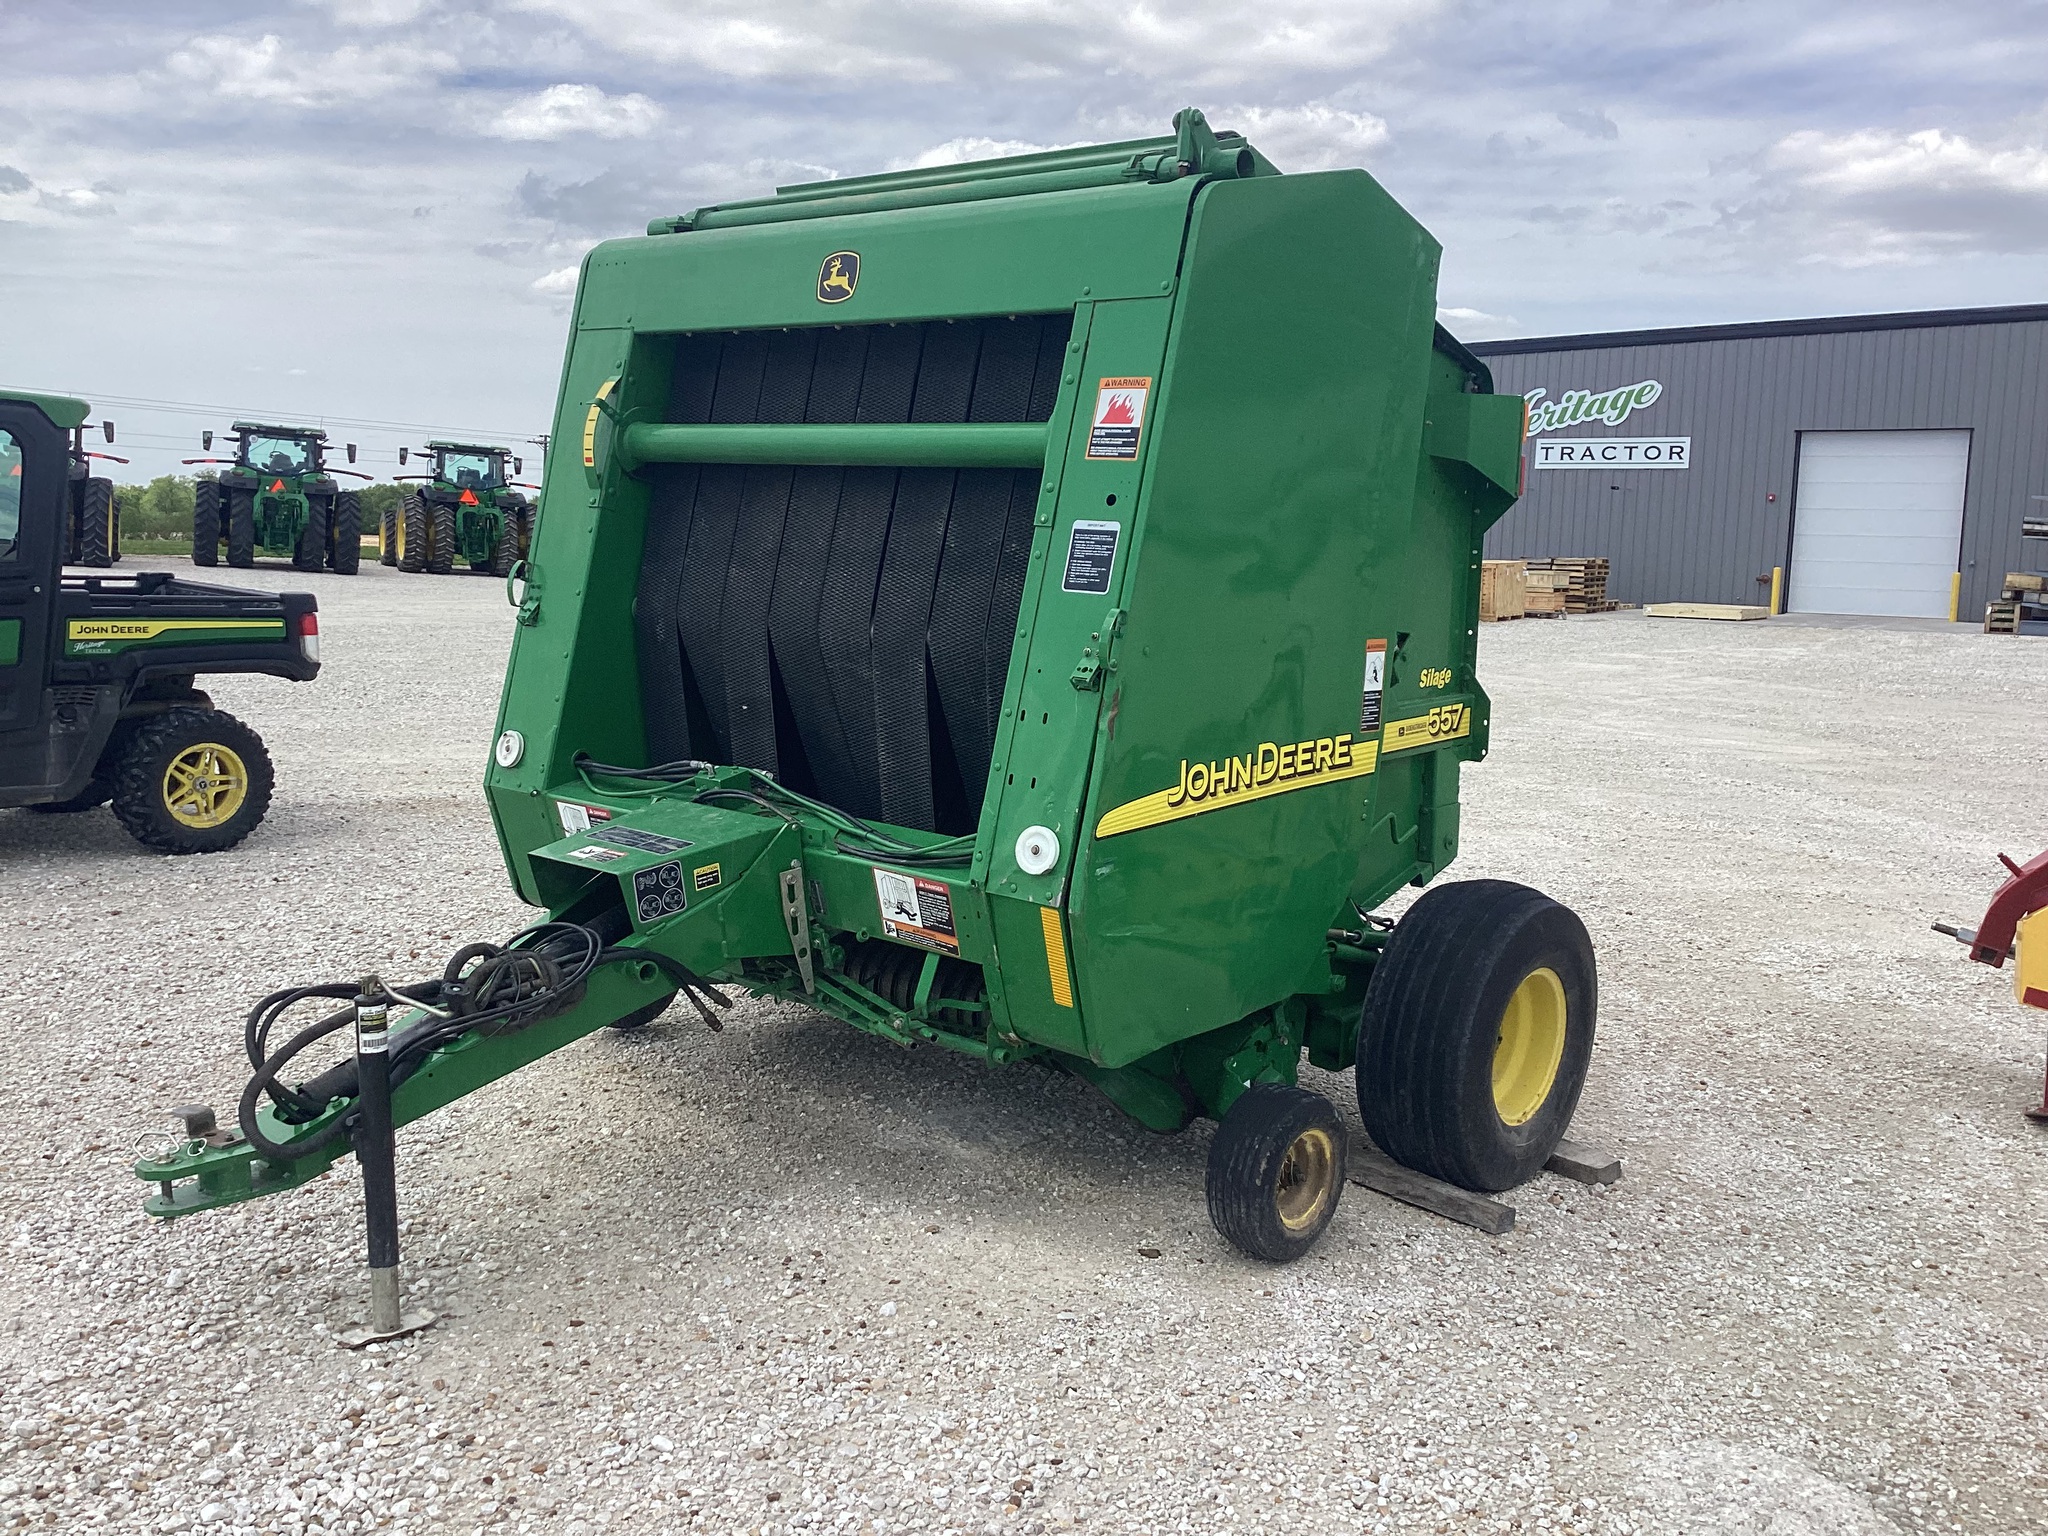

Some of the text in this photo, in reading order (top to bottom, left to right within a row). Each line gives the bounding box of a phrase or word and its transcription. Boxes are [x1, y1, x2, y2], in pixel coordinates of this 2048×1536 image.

[1111, 379, 1147, 387] WARNING
[1540, 445, 1684, 461] TRACTOR
[77, 625, 149, 634] JOHN DEERE
[73, 641, 106, 652] Heritage
[1420, 668, 1452, 688] Silage
[1428, 703, 1463, 736] 557
[1168, 734, 1353, 807] JOHN DEERE
[924, 883, 944, 892] DANGER
